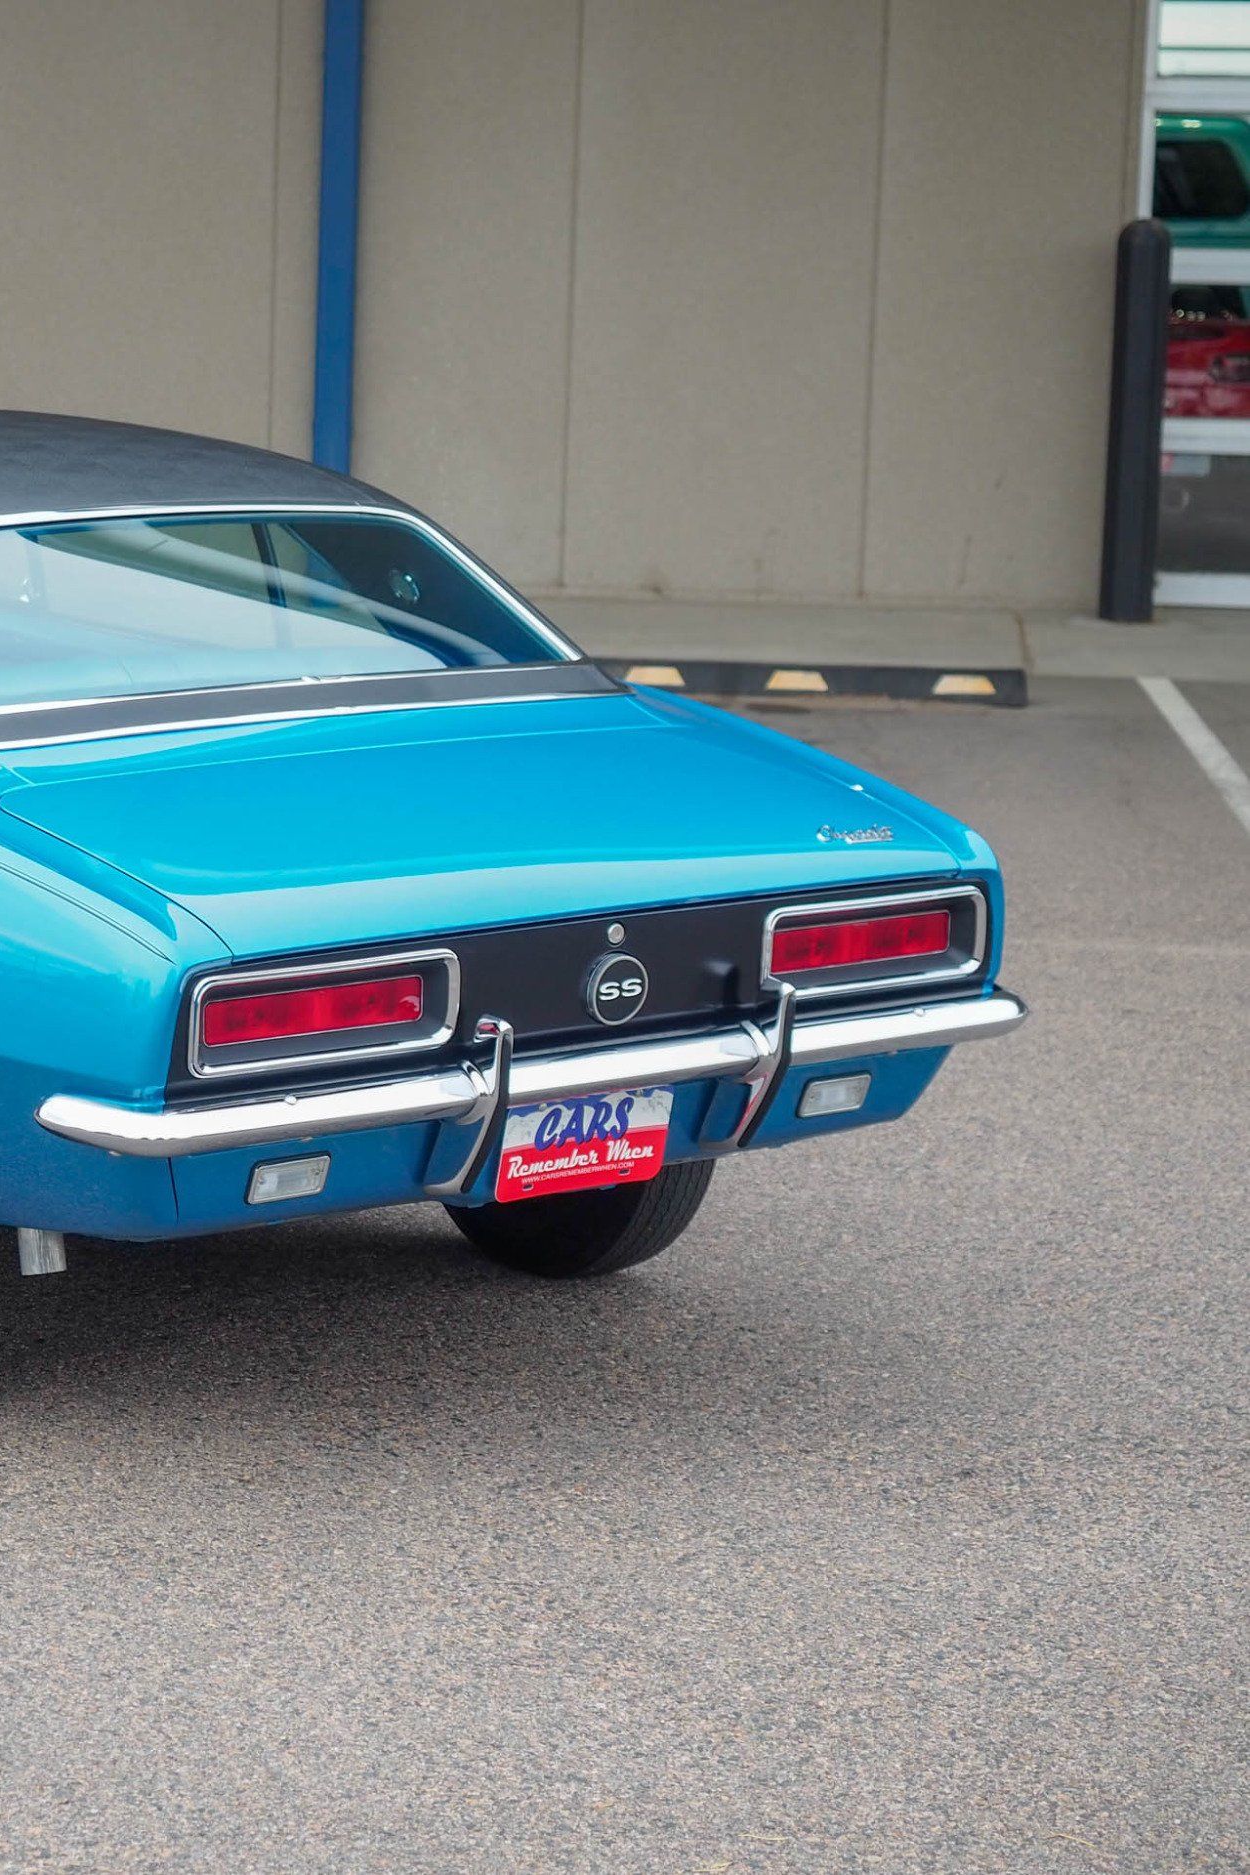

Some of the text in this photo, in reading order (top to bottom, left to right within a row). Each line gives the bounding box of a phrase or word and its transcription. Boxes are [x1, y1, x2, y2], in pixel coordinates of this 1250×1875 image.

[599, 978, 643, 1001] SS
[535, 1097, 635, 1151] CARS
[507, 1140, 654, 1180] Remember When
[521, 1161, 635, 1184] WWW.CARSREMEMBERWHEN.COM
